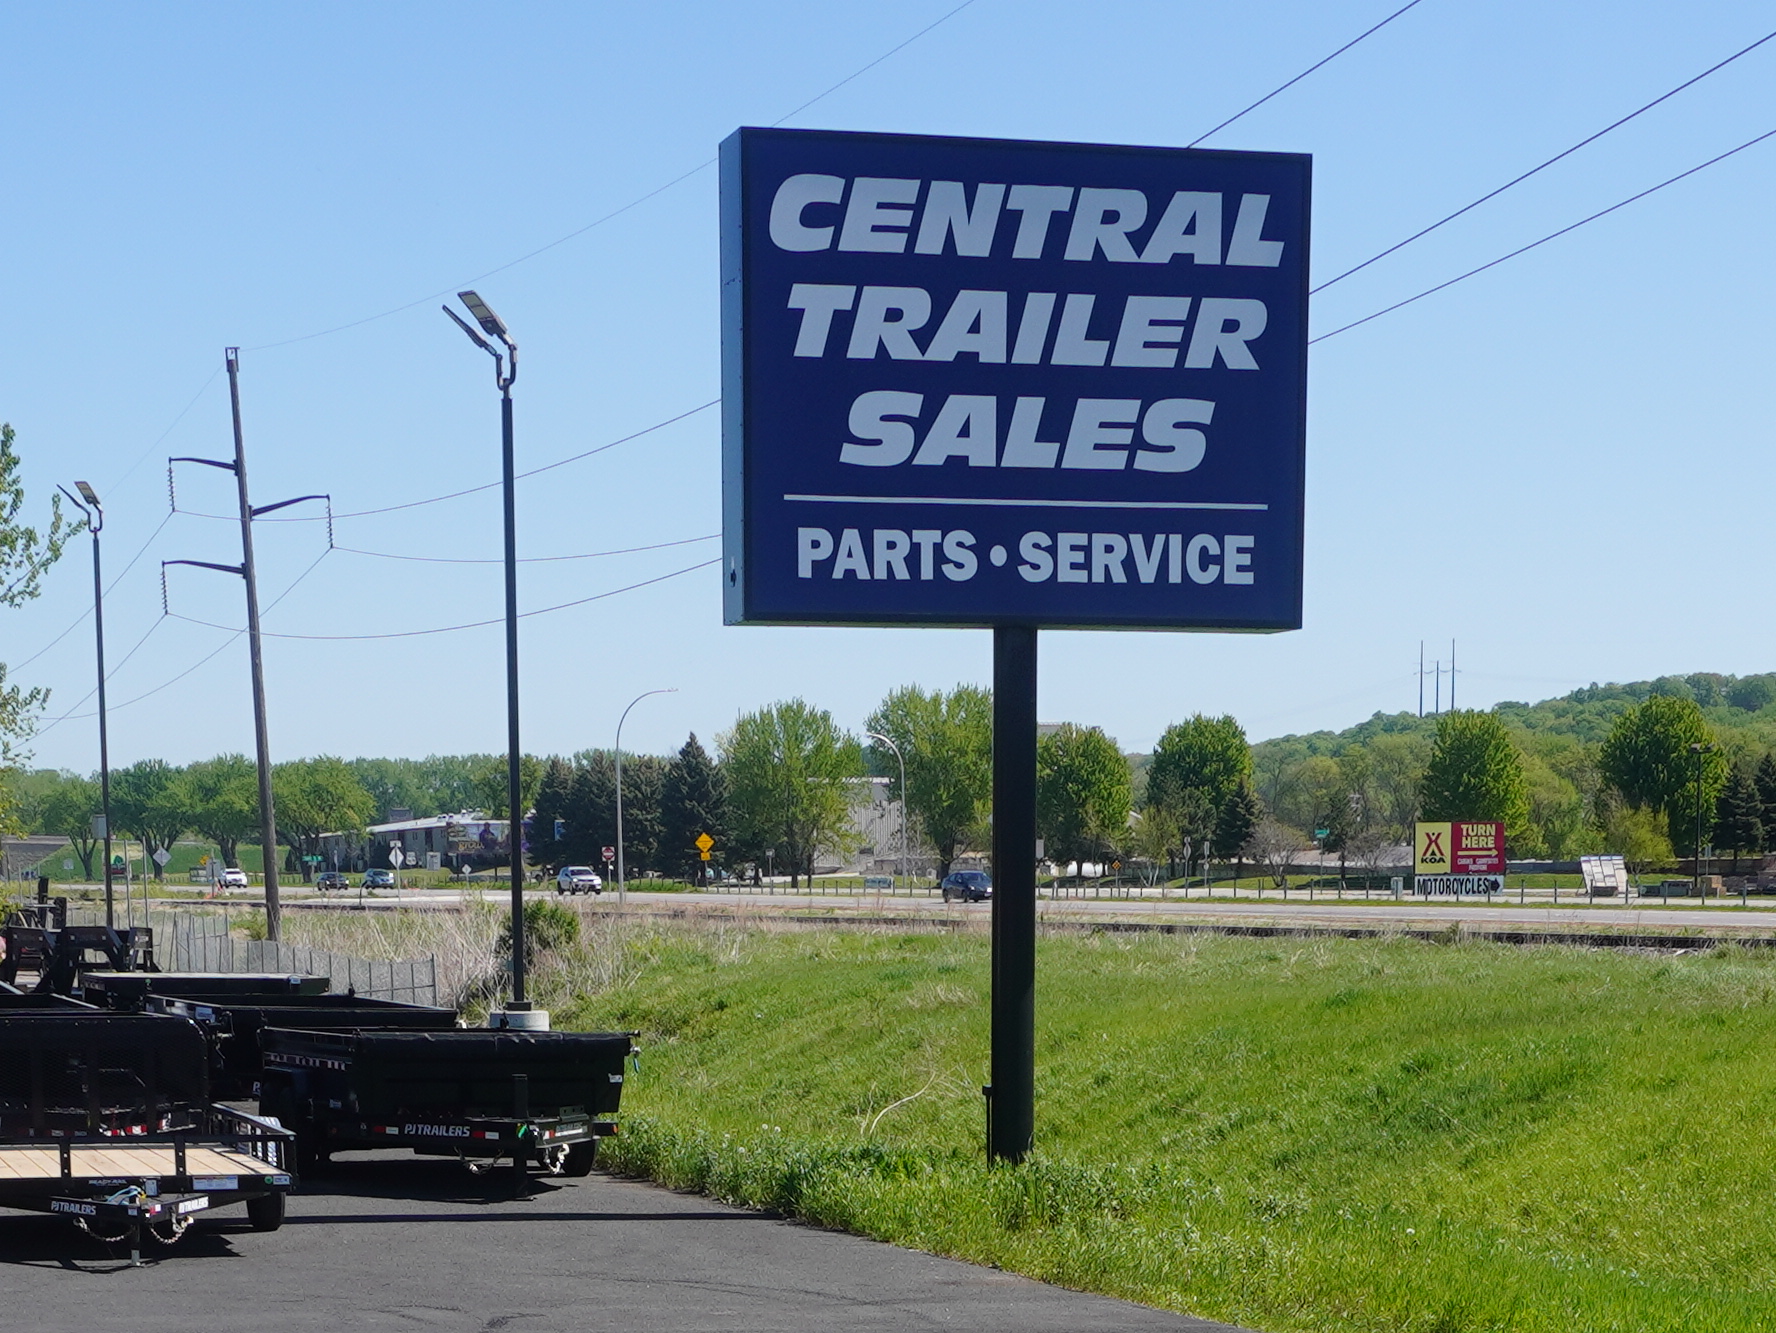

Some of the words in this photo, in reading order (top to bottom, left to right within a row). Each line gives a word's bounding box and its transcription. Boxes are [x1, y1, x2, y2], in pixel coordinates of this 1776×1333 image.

[768, 172, 1285, 268] CENTRAL
[786, 282, 1268, 371] TRAILER
[838, 390, 1216, 474] SALES
[797, 526, 978, 582] PARTS
[1016, 531, 1255, 585] SERVICE
[1461, 823, 1496, 836] TURN
[1462, 836, 1495, 848] HERE
[1417, 877, 1489, 896] MOTORCYCLES
